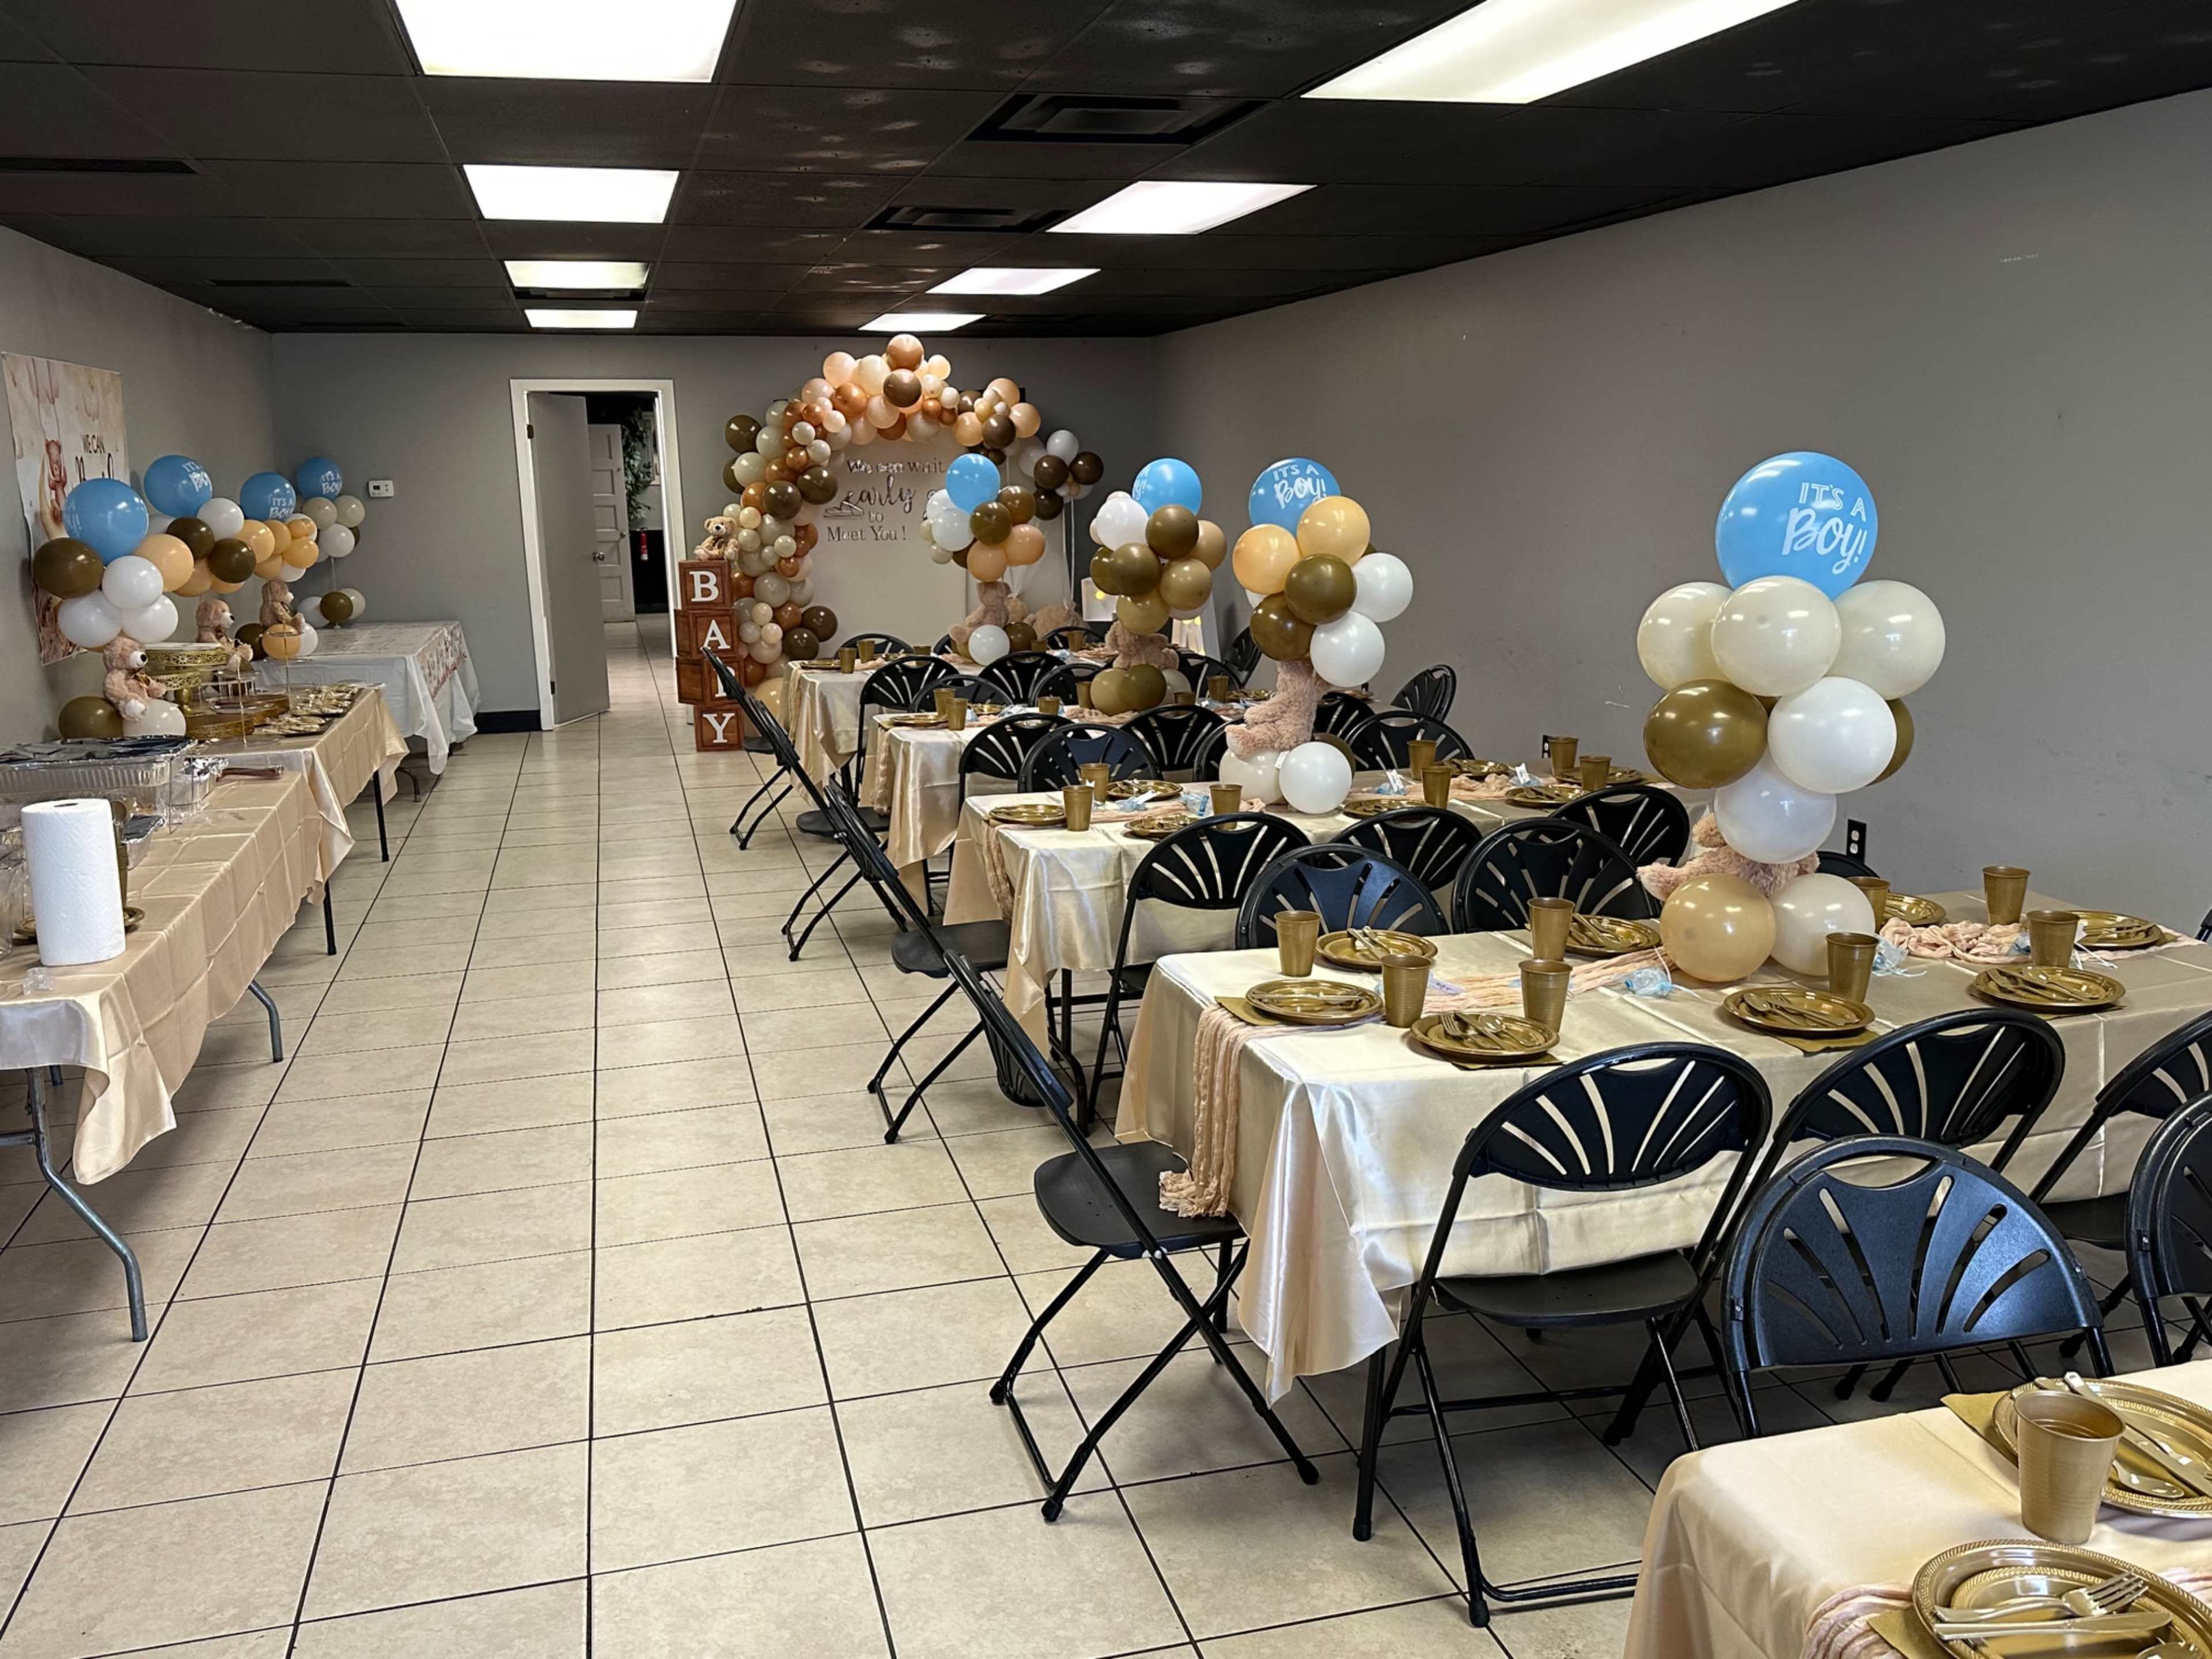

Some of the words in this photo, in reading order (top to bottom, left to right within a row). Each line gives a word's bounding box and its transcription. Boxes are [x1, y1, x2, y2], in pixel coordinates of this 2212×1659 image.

[81, 433, 92, 454] WE
[92, 434, 106, 454] CAN
[908, 457, 946, 474] wait
[1273, 465, 1300, 481] IT'S
[1306, 464, 1319, 475] A
[1798, 482, 1844, 510] IT'S
[1850, 497, 1866, 522] A
[868, 510, 884, 523] to
[826, 526, 865, 541] Meet
